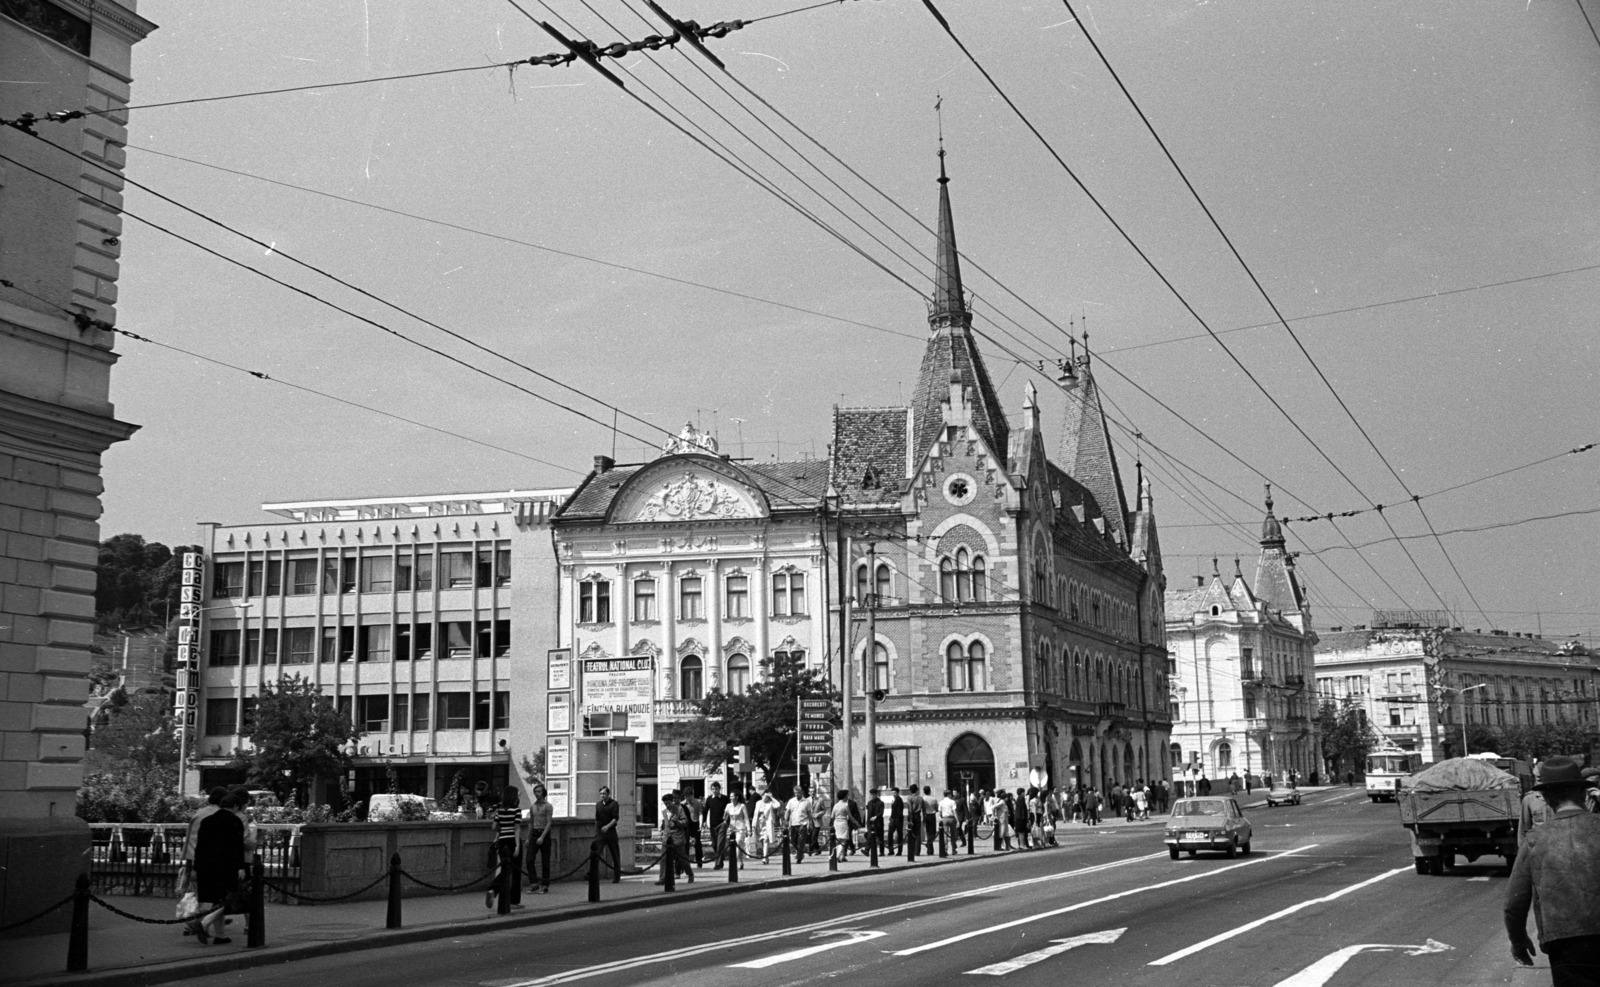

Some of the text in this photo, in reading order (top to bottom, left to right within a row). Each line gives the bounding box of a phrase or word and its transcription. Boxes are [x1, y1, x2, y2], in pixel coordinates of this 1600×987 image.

[182, 554, 192, 617] casa
[192, 555, 202, 618] casa
[180, 628, 188, 659] de
[586, 661, 608, 672] TEATRUL
